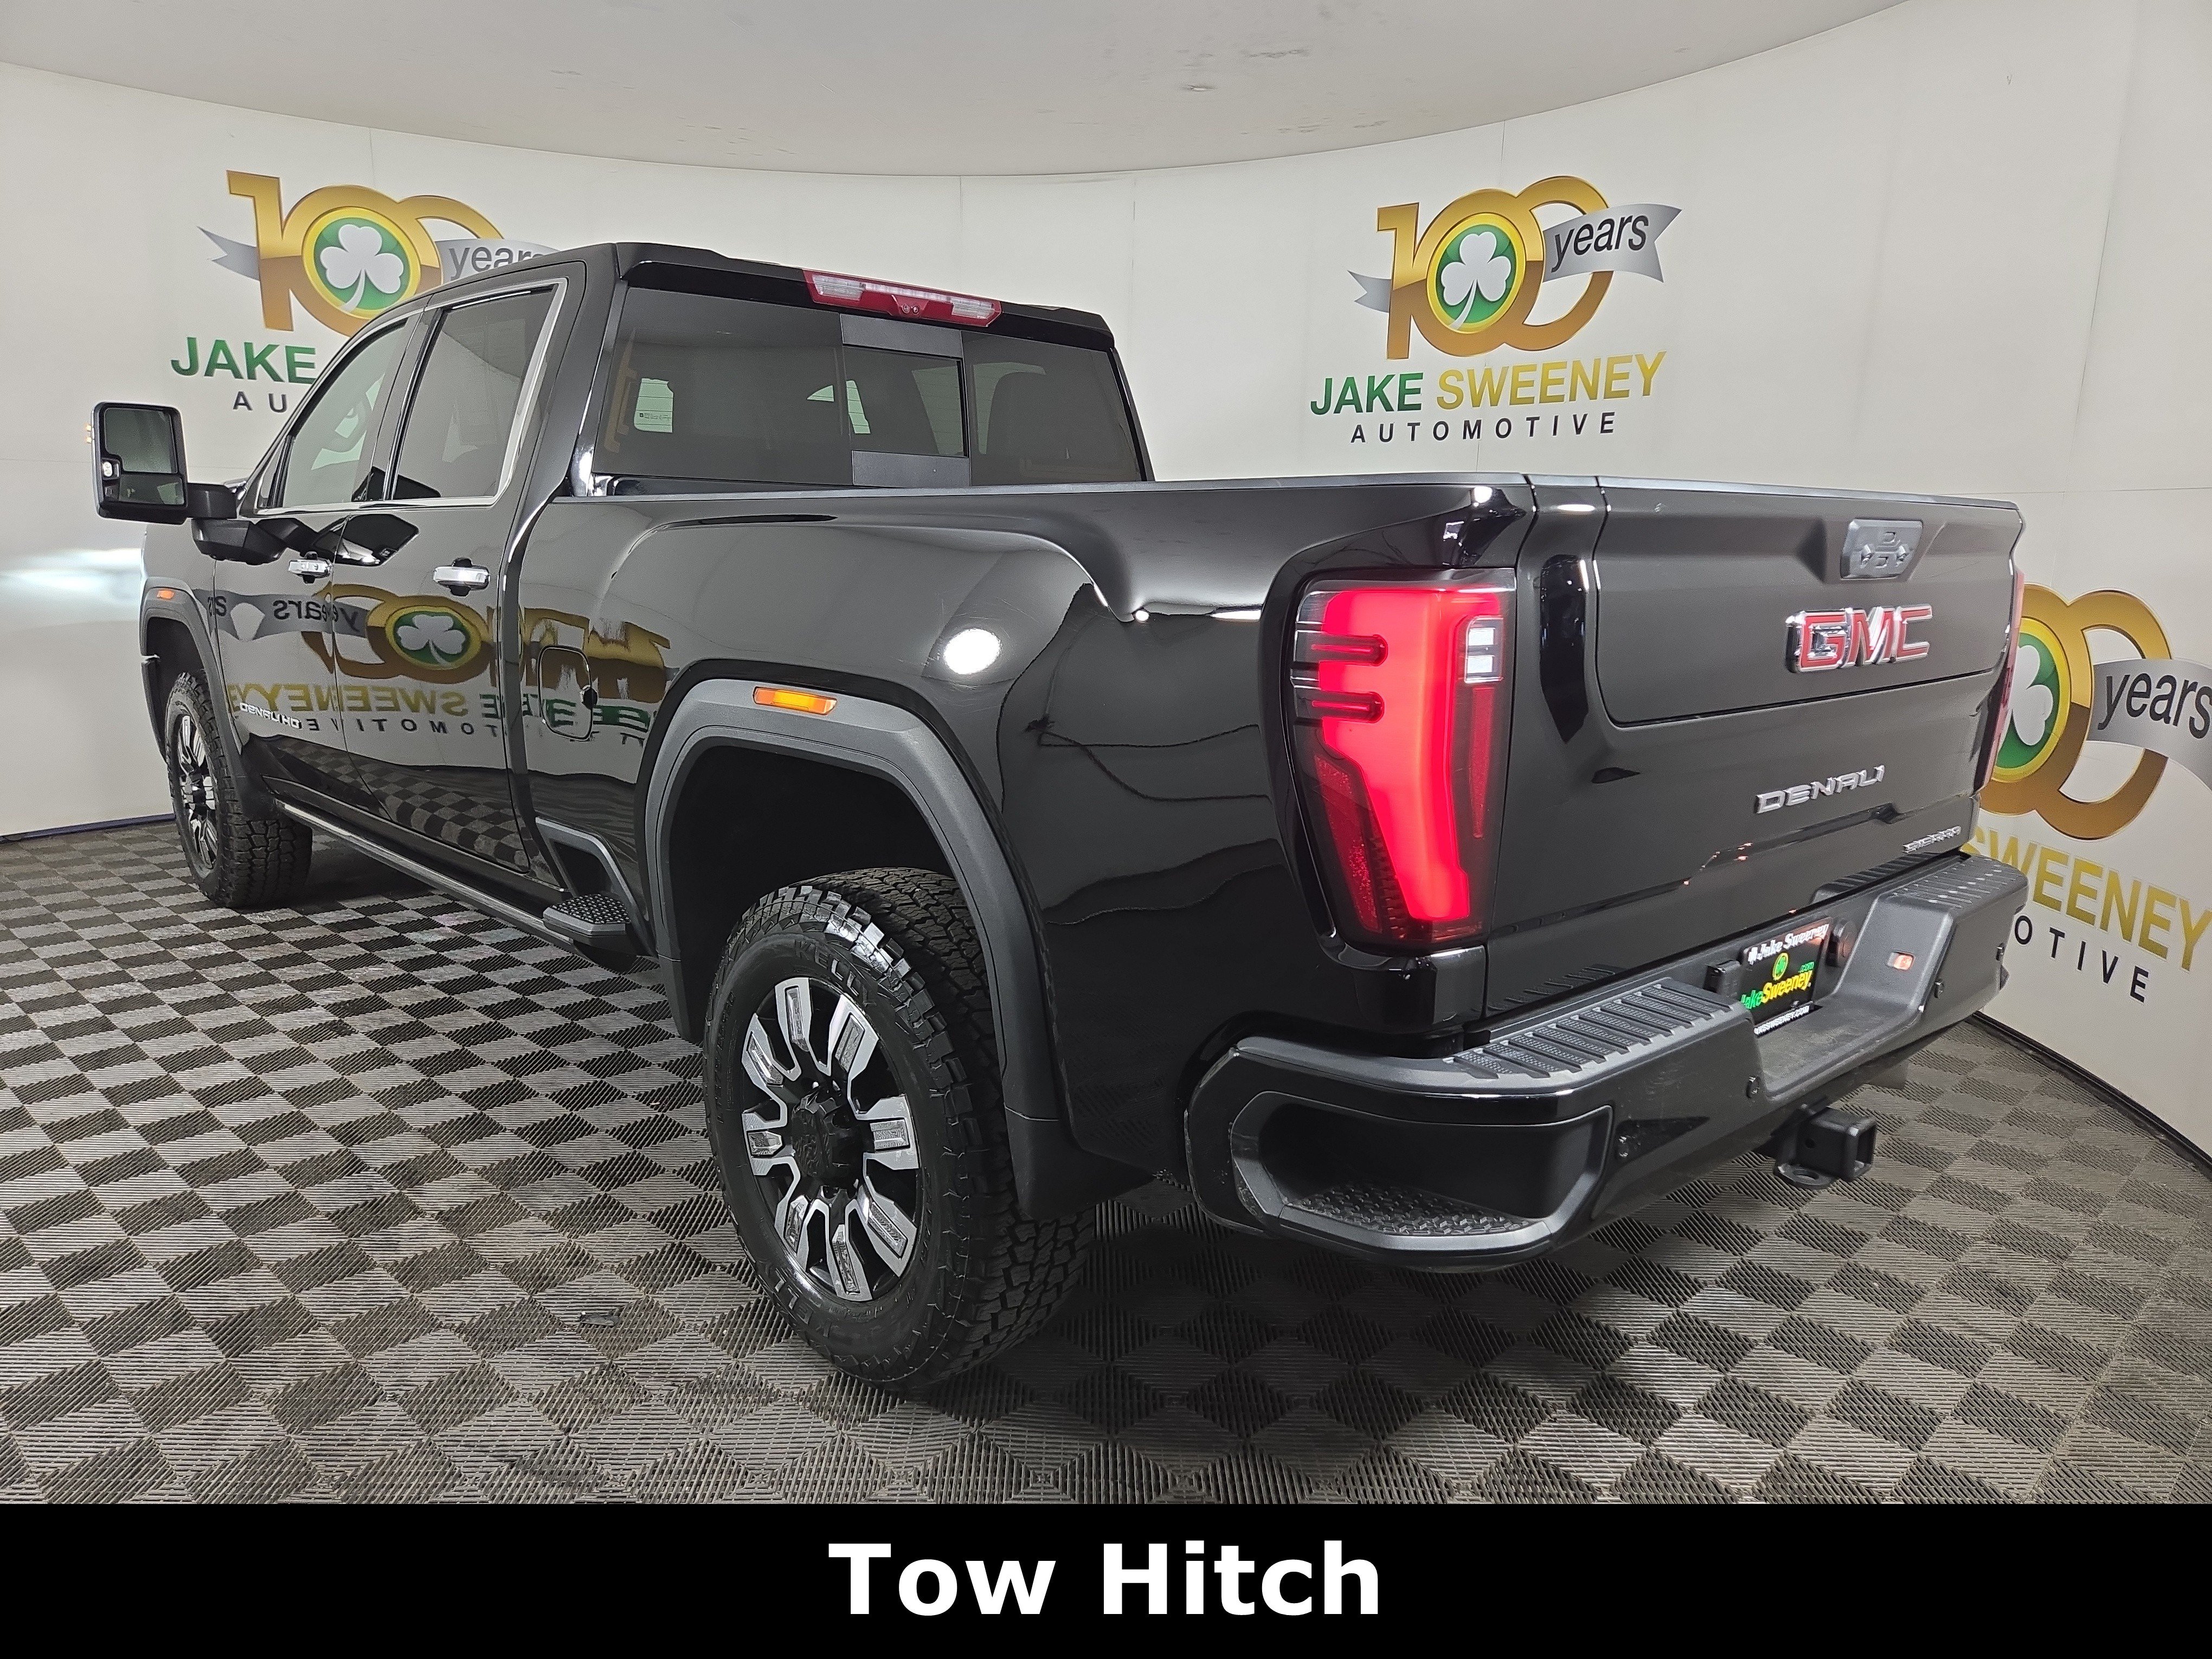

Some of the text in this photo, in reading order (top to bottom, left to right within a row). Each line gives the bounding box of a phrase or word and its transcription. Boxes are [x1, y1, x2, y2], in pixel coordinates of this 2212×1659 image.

[1551, 214, 1649, 273] years
[171, 337, 316, 384] JAKE
[1310, 351, 1667, 415] JAKE SWEENEY
[1351, 411, 1615, 443] AUTOMOTIVE
[1785, 603, 1933, 673] GMC
[1754, 764, 1885, 814] DENALI
[1784, 924, 1829, 949] Sweeney
